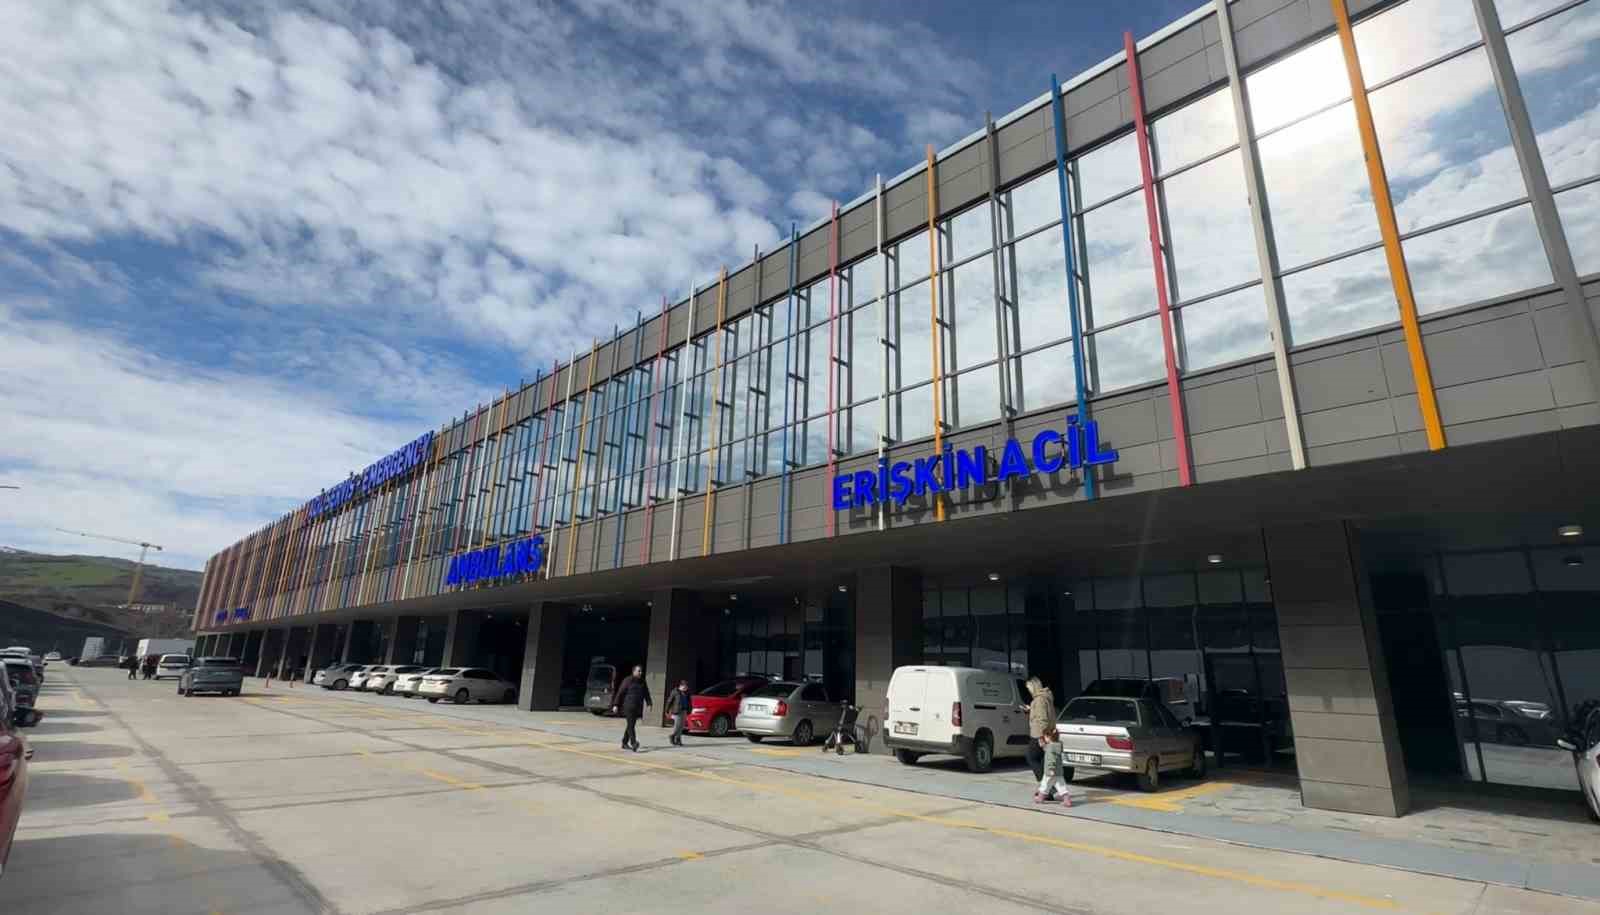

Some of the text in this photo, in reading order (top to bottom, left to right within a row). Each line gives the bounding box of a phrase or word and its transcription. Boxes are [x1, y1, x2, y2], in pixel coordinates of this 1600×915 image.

[361, 430, 434, 492] EMERGENCY
[833, 414, 1119, 511] ERİŞKİN ACİL
[446, 536, 545, 586] AMBULANS
